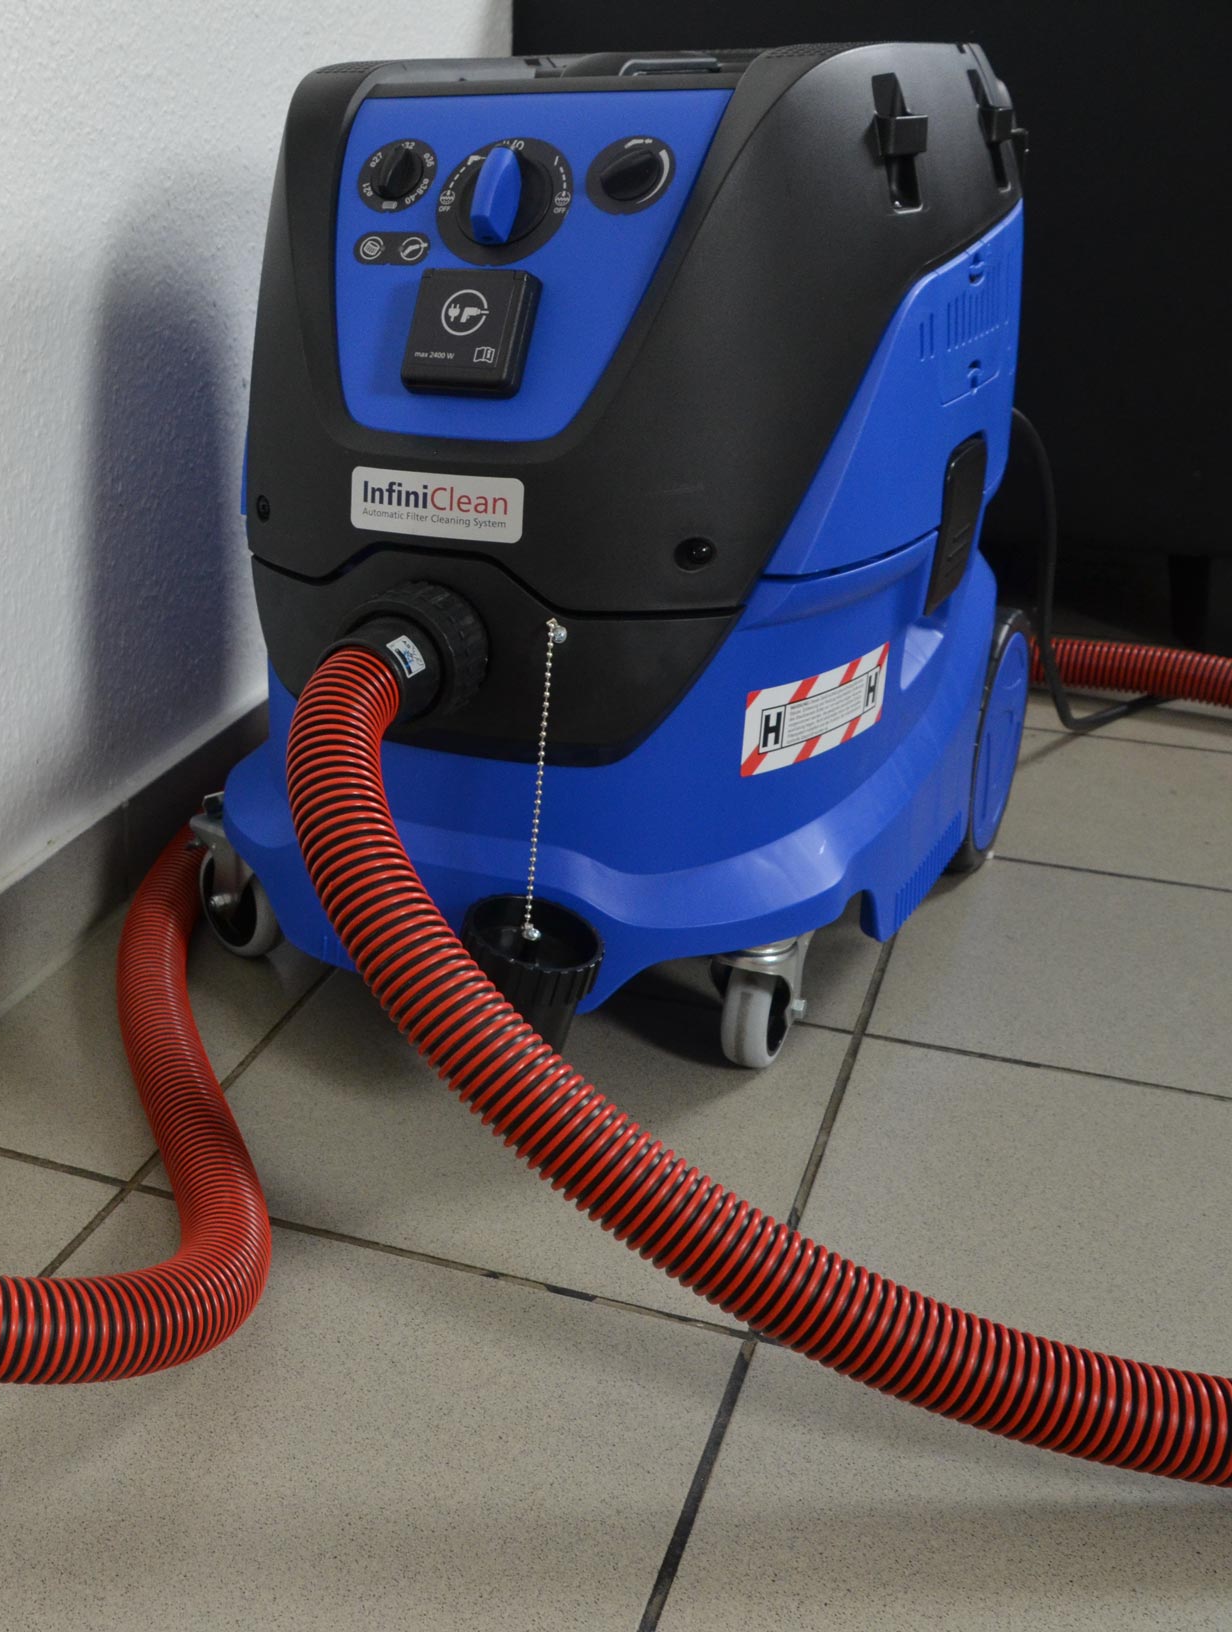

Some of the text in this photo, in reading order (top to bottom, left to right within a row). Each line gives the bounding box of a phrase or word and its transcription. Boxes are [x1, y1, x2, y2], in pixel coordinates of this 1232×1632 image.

[438, 205, 451, 213] OFF
[429, 351, 446, 359] 2400
[363, 480, 508, 515] InfiniClean
[363, 507, 507, 529] Automatic Filter Cleaning System
[866, 672, 878, 707] H
[762, 711, 783, 748] H
